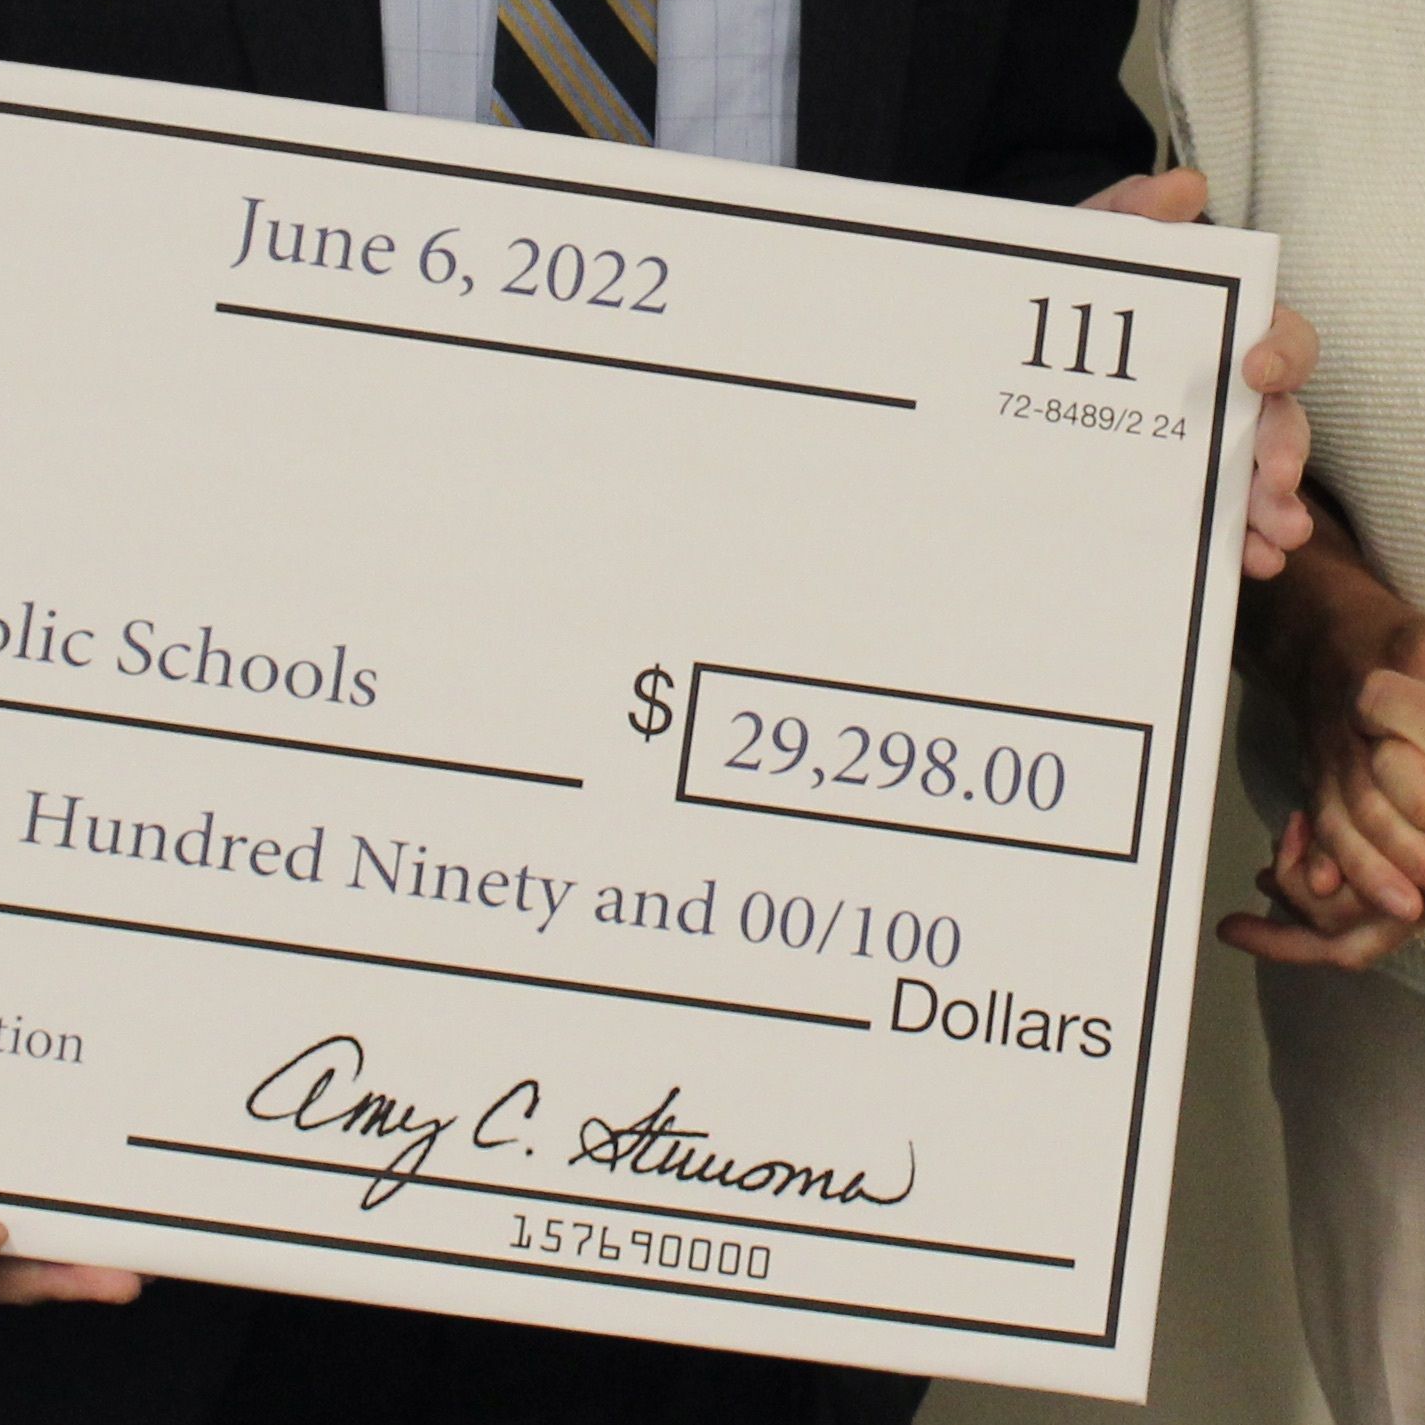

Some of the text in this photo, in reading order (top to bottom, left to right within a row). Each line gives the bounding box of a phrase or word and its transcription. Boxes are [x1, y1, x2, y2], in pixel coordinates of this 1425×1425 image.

[229, 196, 669, 315] June 6, 2022
[1020, 296, 1138, 382] 111
[116, 619, 378, 708] Schools
[627, 661, 1066, 812] $ 29,298.00
[19, 789, 325, 883] Hundred
[345, 834, 579, 935] Ninety
[594, 879, 717, 936] and
[739, 890, 962, 969] 00/100
[889, 976, 1113, 1060] Dollars
[509, 1213, 772, 1281] 157690000
